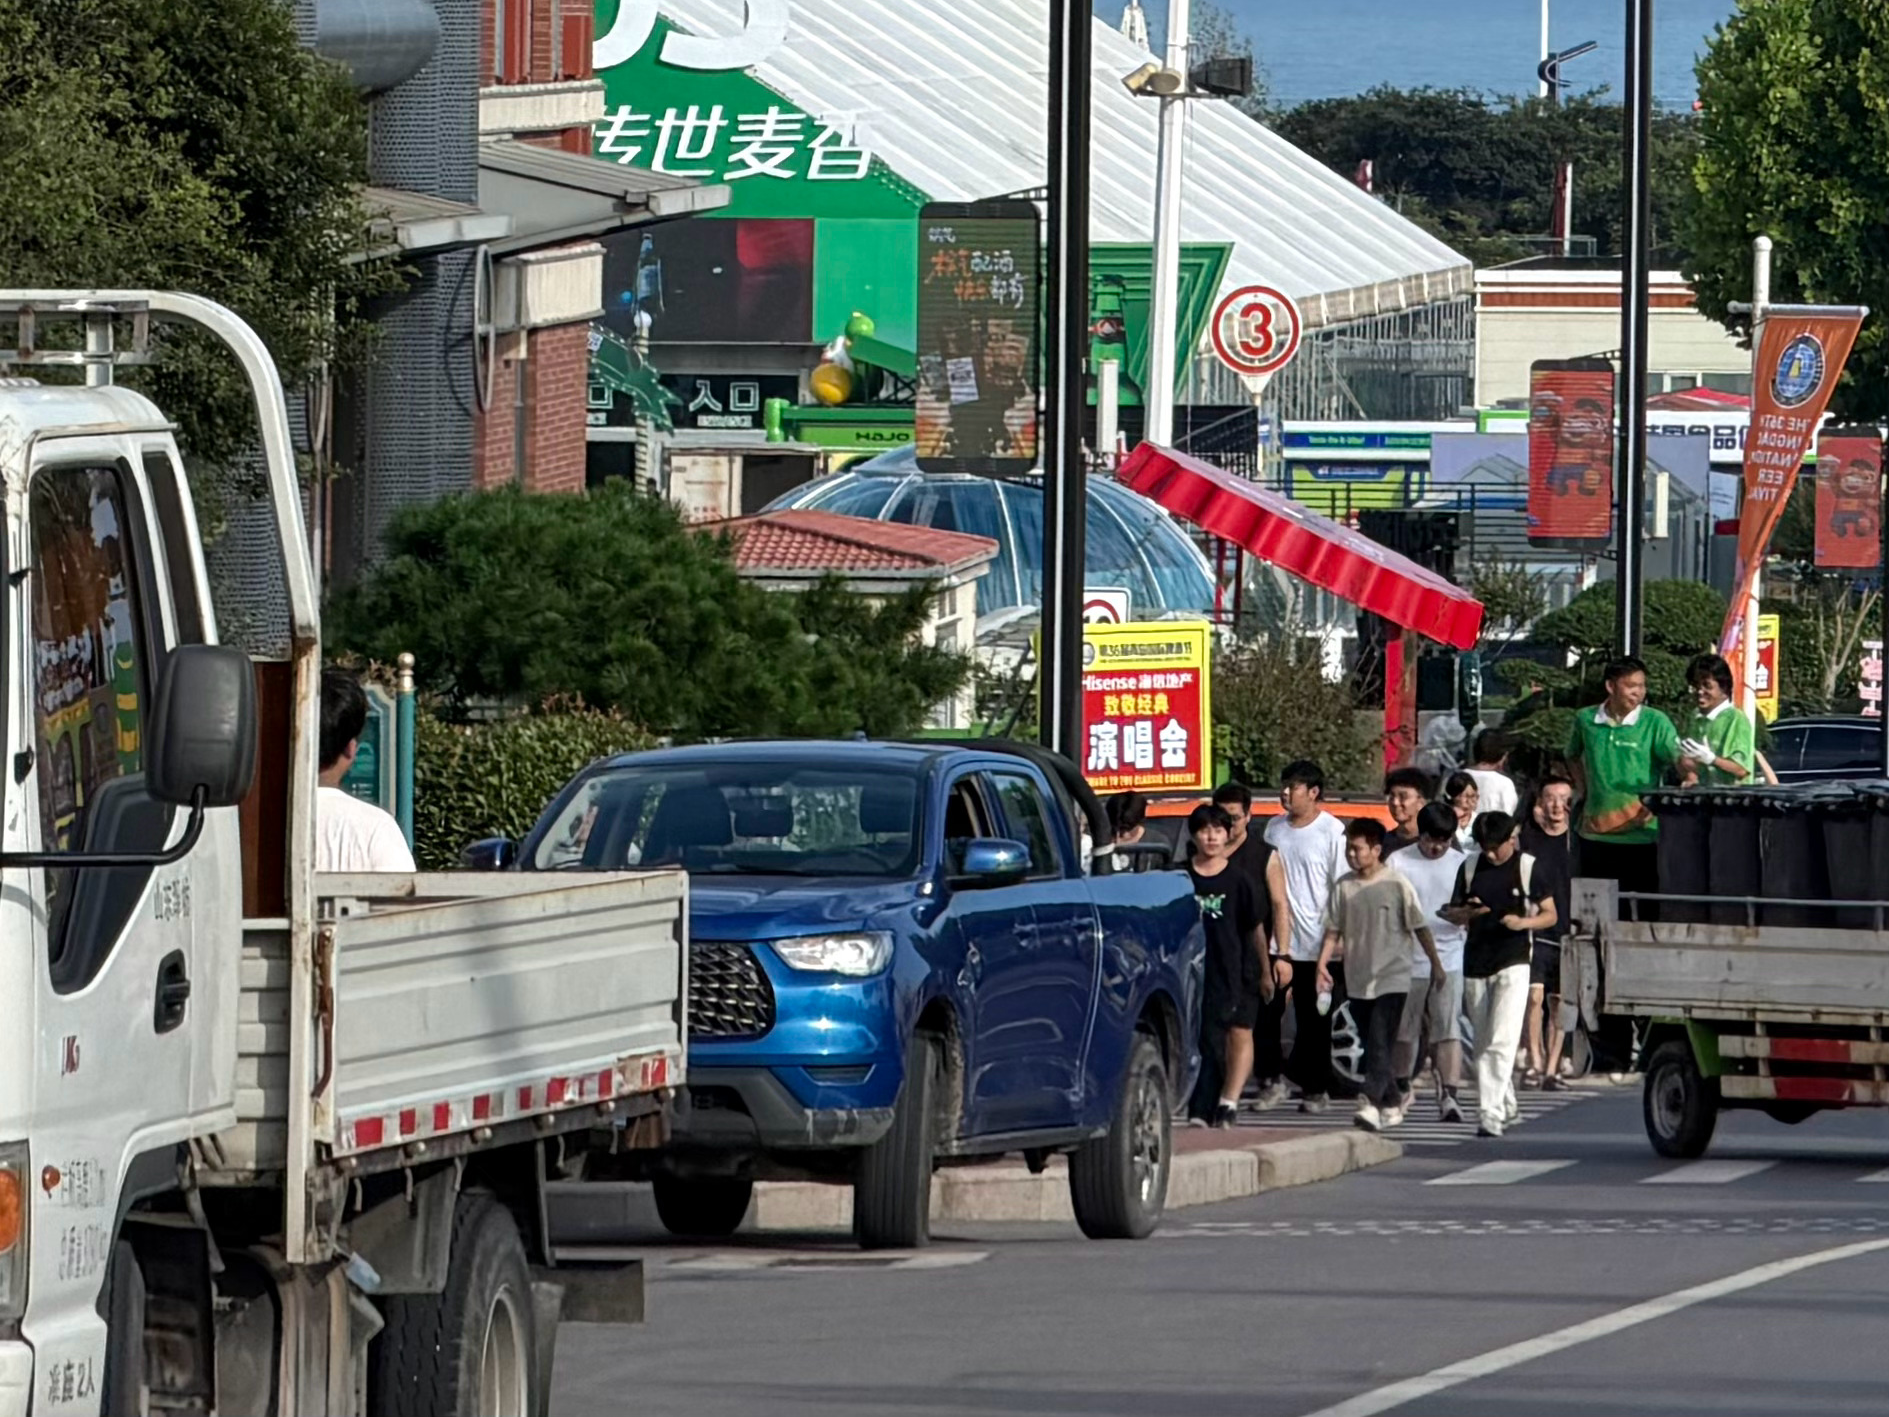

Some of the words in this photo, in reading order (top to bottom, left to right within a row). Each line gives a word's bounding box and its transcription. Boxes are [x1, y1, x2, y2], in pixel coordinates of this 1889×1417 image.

[1239, 301, 1275, 356] 3
[689, 379, 760, 412] 入口
[1087, 718, 1188, 771] 演唱会
